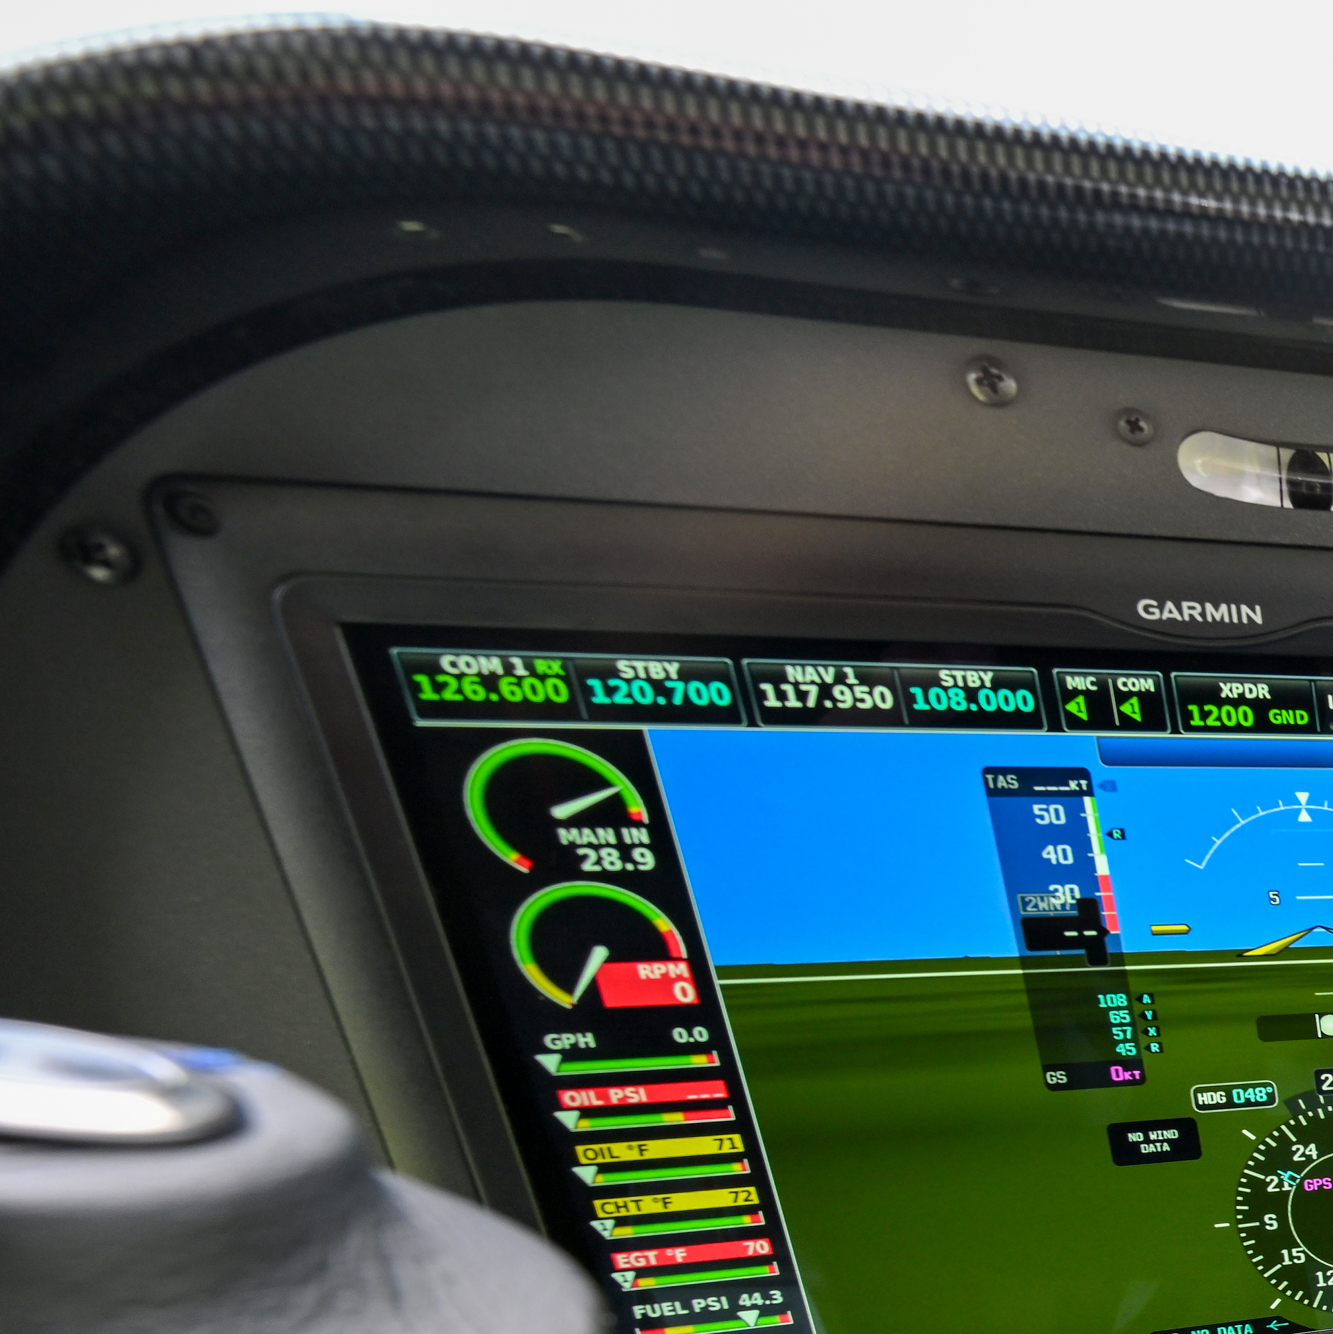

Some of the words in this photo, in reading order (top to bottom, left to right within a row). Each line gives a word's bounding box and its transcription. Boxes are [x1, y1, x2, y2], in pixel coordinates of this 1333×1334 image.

[1137, 599, 1263, 625] GARMIN
[440, 654, 503, 675] COM
[533, 659, 565, 676] RX
[615, 660, 680, 680] STBY
[785, 665, 836, 684] NAV
[939, 669, 994, 688] STBY
[1065, 676, 1099, 692] MIC
[1117, 677, 1155, 693] COM
[412, 674, 570, 703] 126.600
[586, 678, 732, 707] 120.700
[759, 683, 894, 710] 117.950
[1219, 682, 1271, 700] XPDR
[909, 686, 1035, 713] 108.000
[1187, 704, 1254, 727] 1200
[1268, 708, 1309, 726] GND
[985, 774, 1019, 789] TAS
[1032, 804, 1066, 825] 50
[557, 827, 617, 846] MAN
[621, 827, 651, 845] IN
[576, 847, 656, 872] 28.9
[1041, 844, 1074, 865] 40
[637, 963, 689, 980] RPM
[1097, 994, 1128, 1008] 108
[1109, 1010, 1131, 1024] 65
[543, 1031, 597, 1050] GPH
[671, 1026, 709, 1043] 0.0
[1112, 1026, 1133, 1040] 57
[1115, 1043, 1137, 1056] 45
[1046, 1071, 1068, 1084] GS
[563, 1091, 604, 1107] OIL
[608, 1087, 648, 1106] PSI
[1197, 1092, 1227, 1105] HDG
[1232, 1086, 1273, 1104] 048°
[583, 1146, 621, 1162] OIL
[713, 1136, 738, 1151] 71
[1140, 1142, 1170, 1154] DATA
[1291, 1143, 1318, 1161] 24
[1303, 1178, 1333, 1191] GPS
[600, 1199, 644, 1216] CHT
[728, 1190, 754, 1204] 72
[615, 1251, 659, 1268] EGT
[742, 1240, 769, 1255] 70
[1280, 1248, 1306, 1266] 15
[632, 1300, 689, 1320] FUEL
[692, 1296, 729, 1313] PSI
[738, 1290, 784, 1307] 44.3
